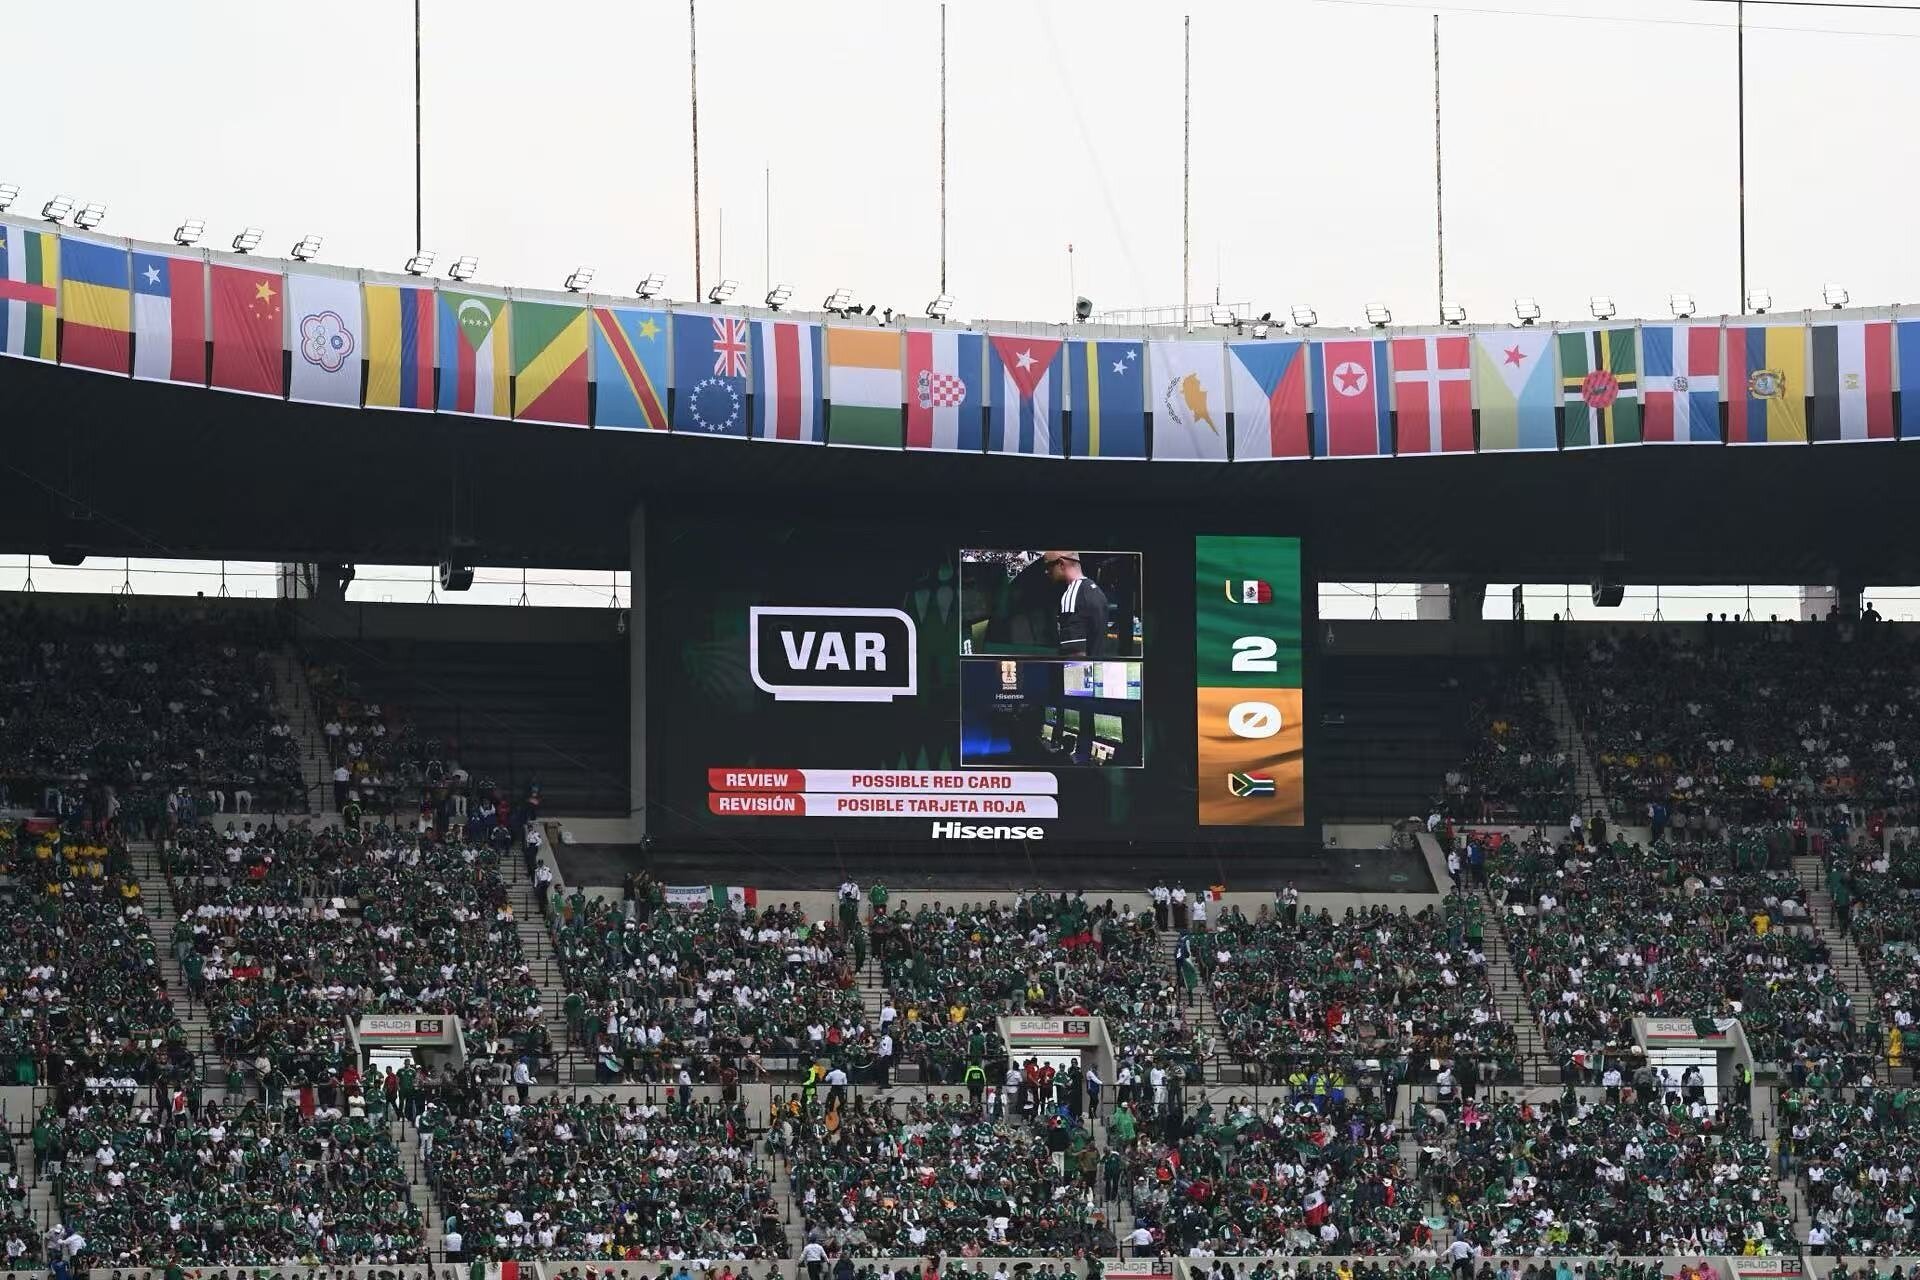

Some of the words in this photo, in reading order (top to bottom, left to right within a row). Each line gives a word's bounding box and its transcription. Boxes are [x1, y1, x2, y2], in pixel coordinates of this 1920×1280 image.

[780, 631, 887, 671] VAR
[1231, 635, 1278, 672] 2
[1228, 701, 1282, 738] 0
[726, 773, 788, 787] REVIEW
[852, 775, 928, 788] POSSIBLE
[933, 776, 963, 788] RED
[968, 776, 1012, 789] CARD
[719, 795, 795, 811] REVISIÓN
[837, 799, 904, 812] POSIBLE
[908, 799, 979, 812] TARJETA
[983, 800, 1026, 813] ROJA
[931, 821, 1044, 840] Hisense
[370, 1021, 411, 1030] SALIDA
[420, 1021, 439, 1032] 66
[1020, 1021, 1059, 1030] SALIDA
[1068, 1021, 1086, 1033] 65
[1107, 1262, 1147, 1271] SALIDA
[1737, 1261, 1777, 1269] SALIDA
[1782, 1261, 1801, 1273] 22
